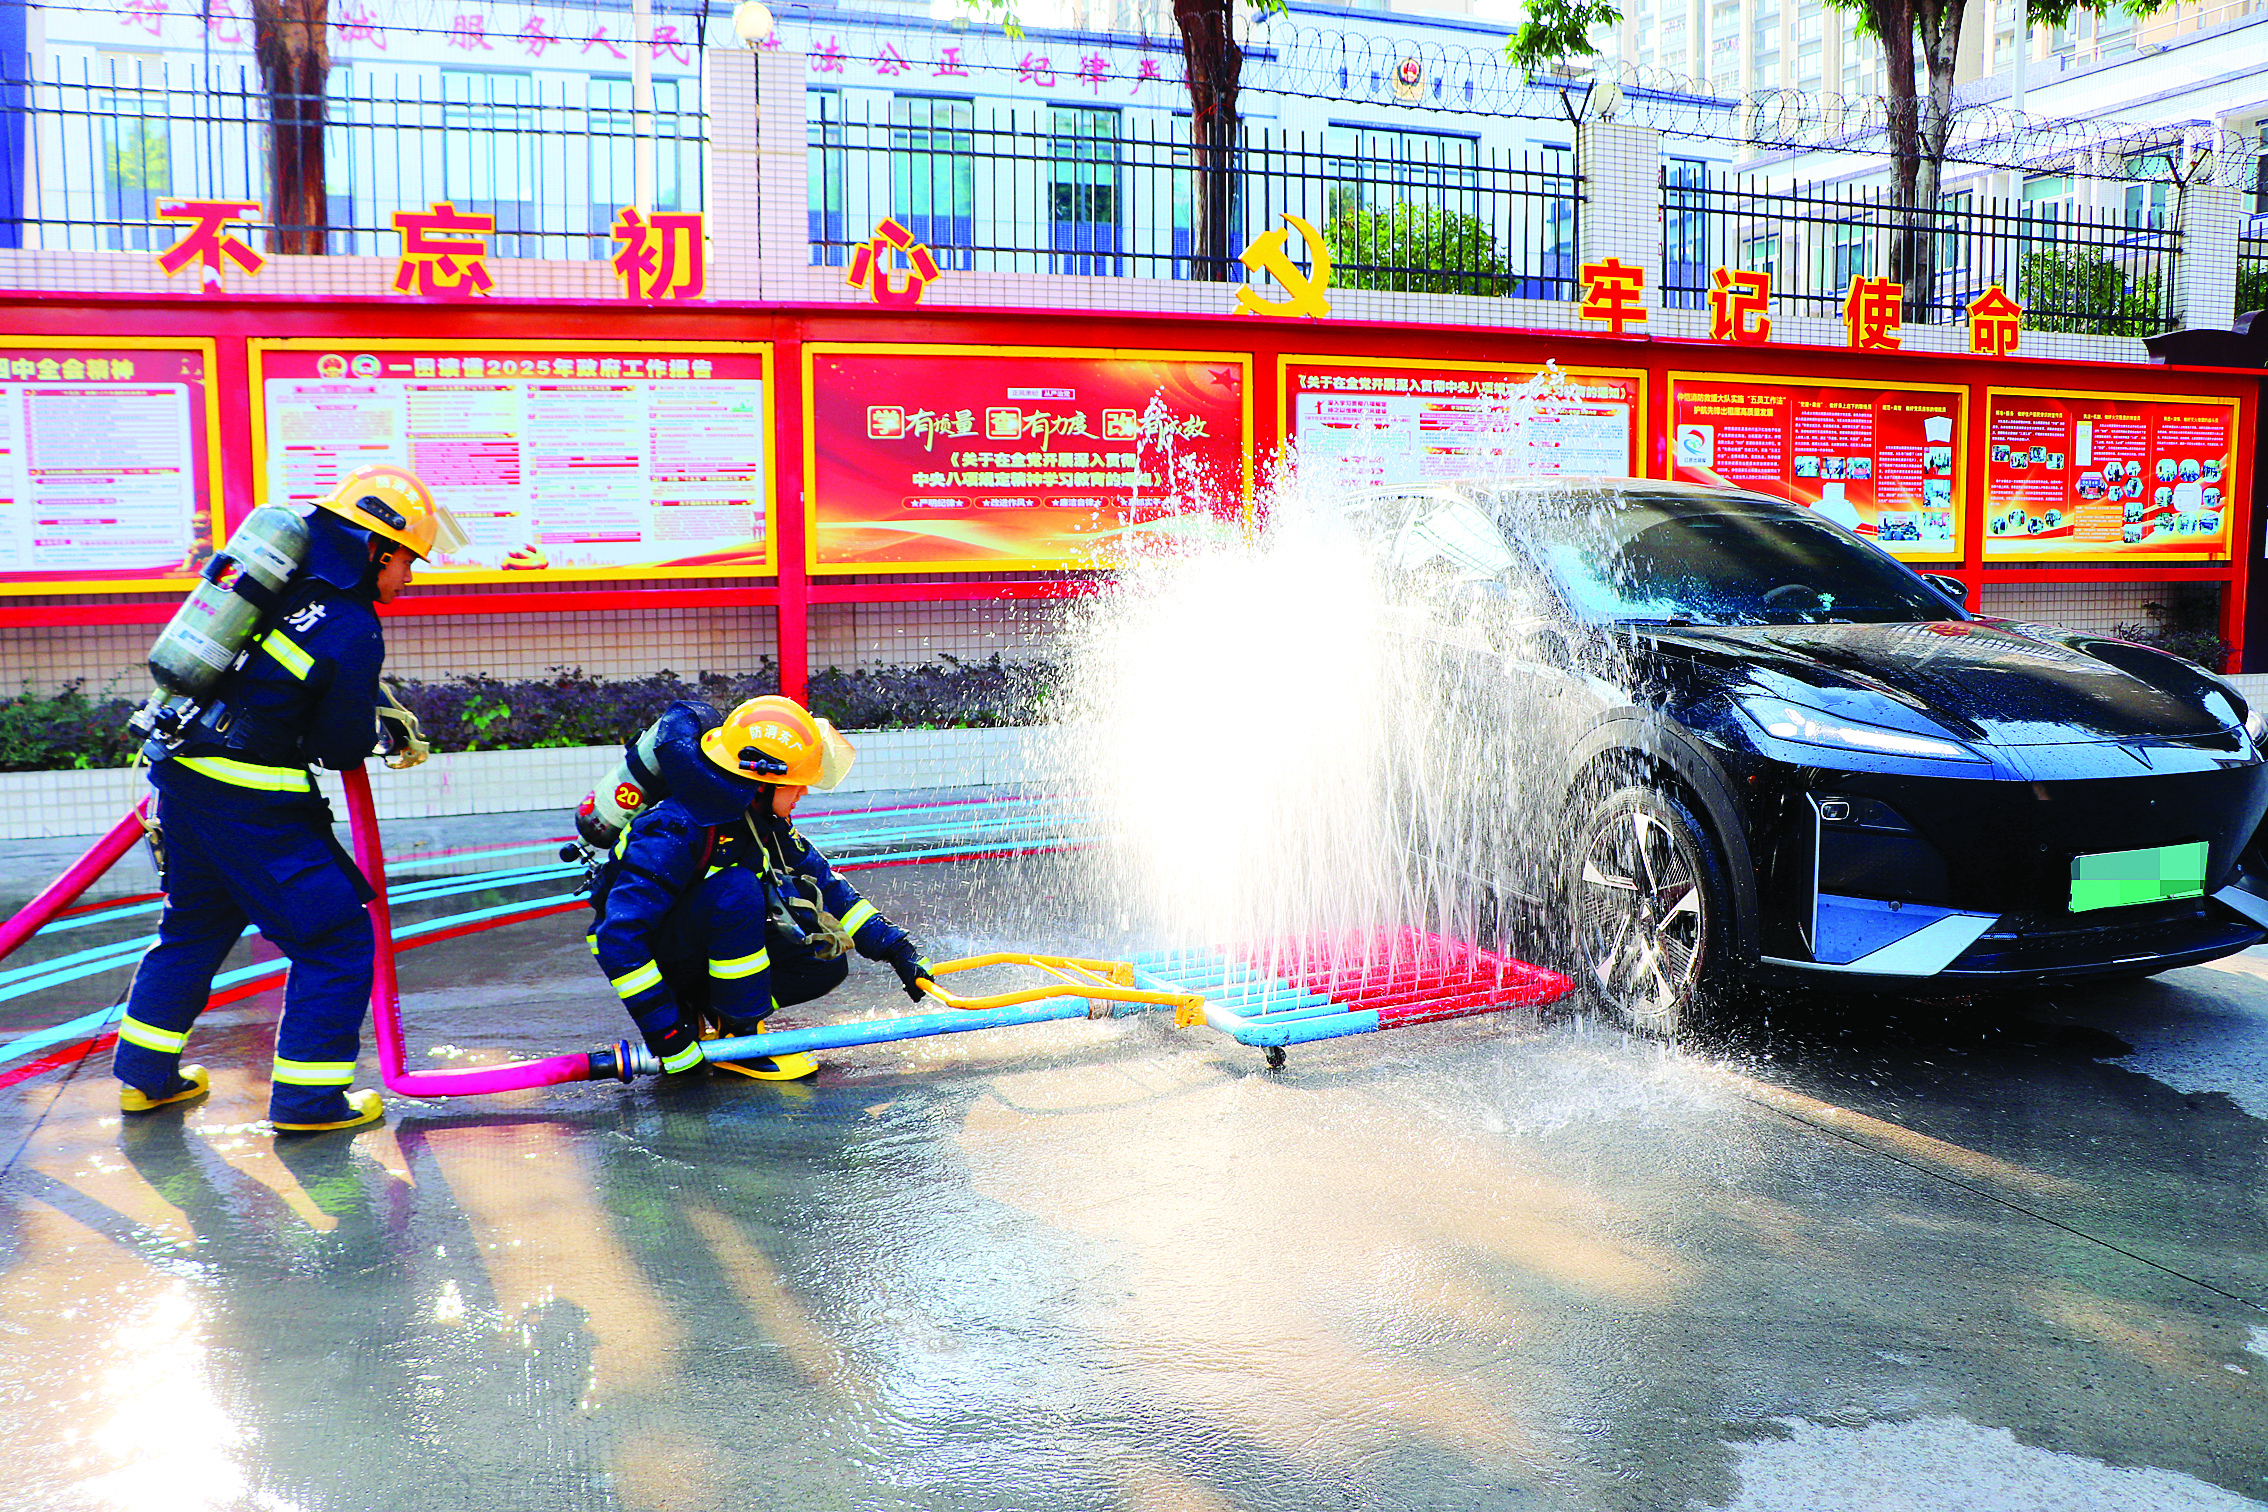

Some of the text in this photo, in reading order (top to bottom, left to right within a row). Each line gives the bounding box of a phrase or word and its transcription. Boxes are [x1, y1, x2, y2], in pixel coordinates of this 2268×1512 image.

[155, 197, 2024, 357] 不忘初心 牢记使命
[616, 786, 640, 806] 20
